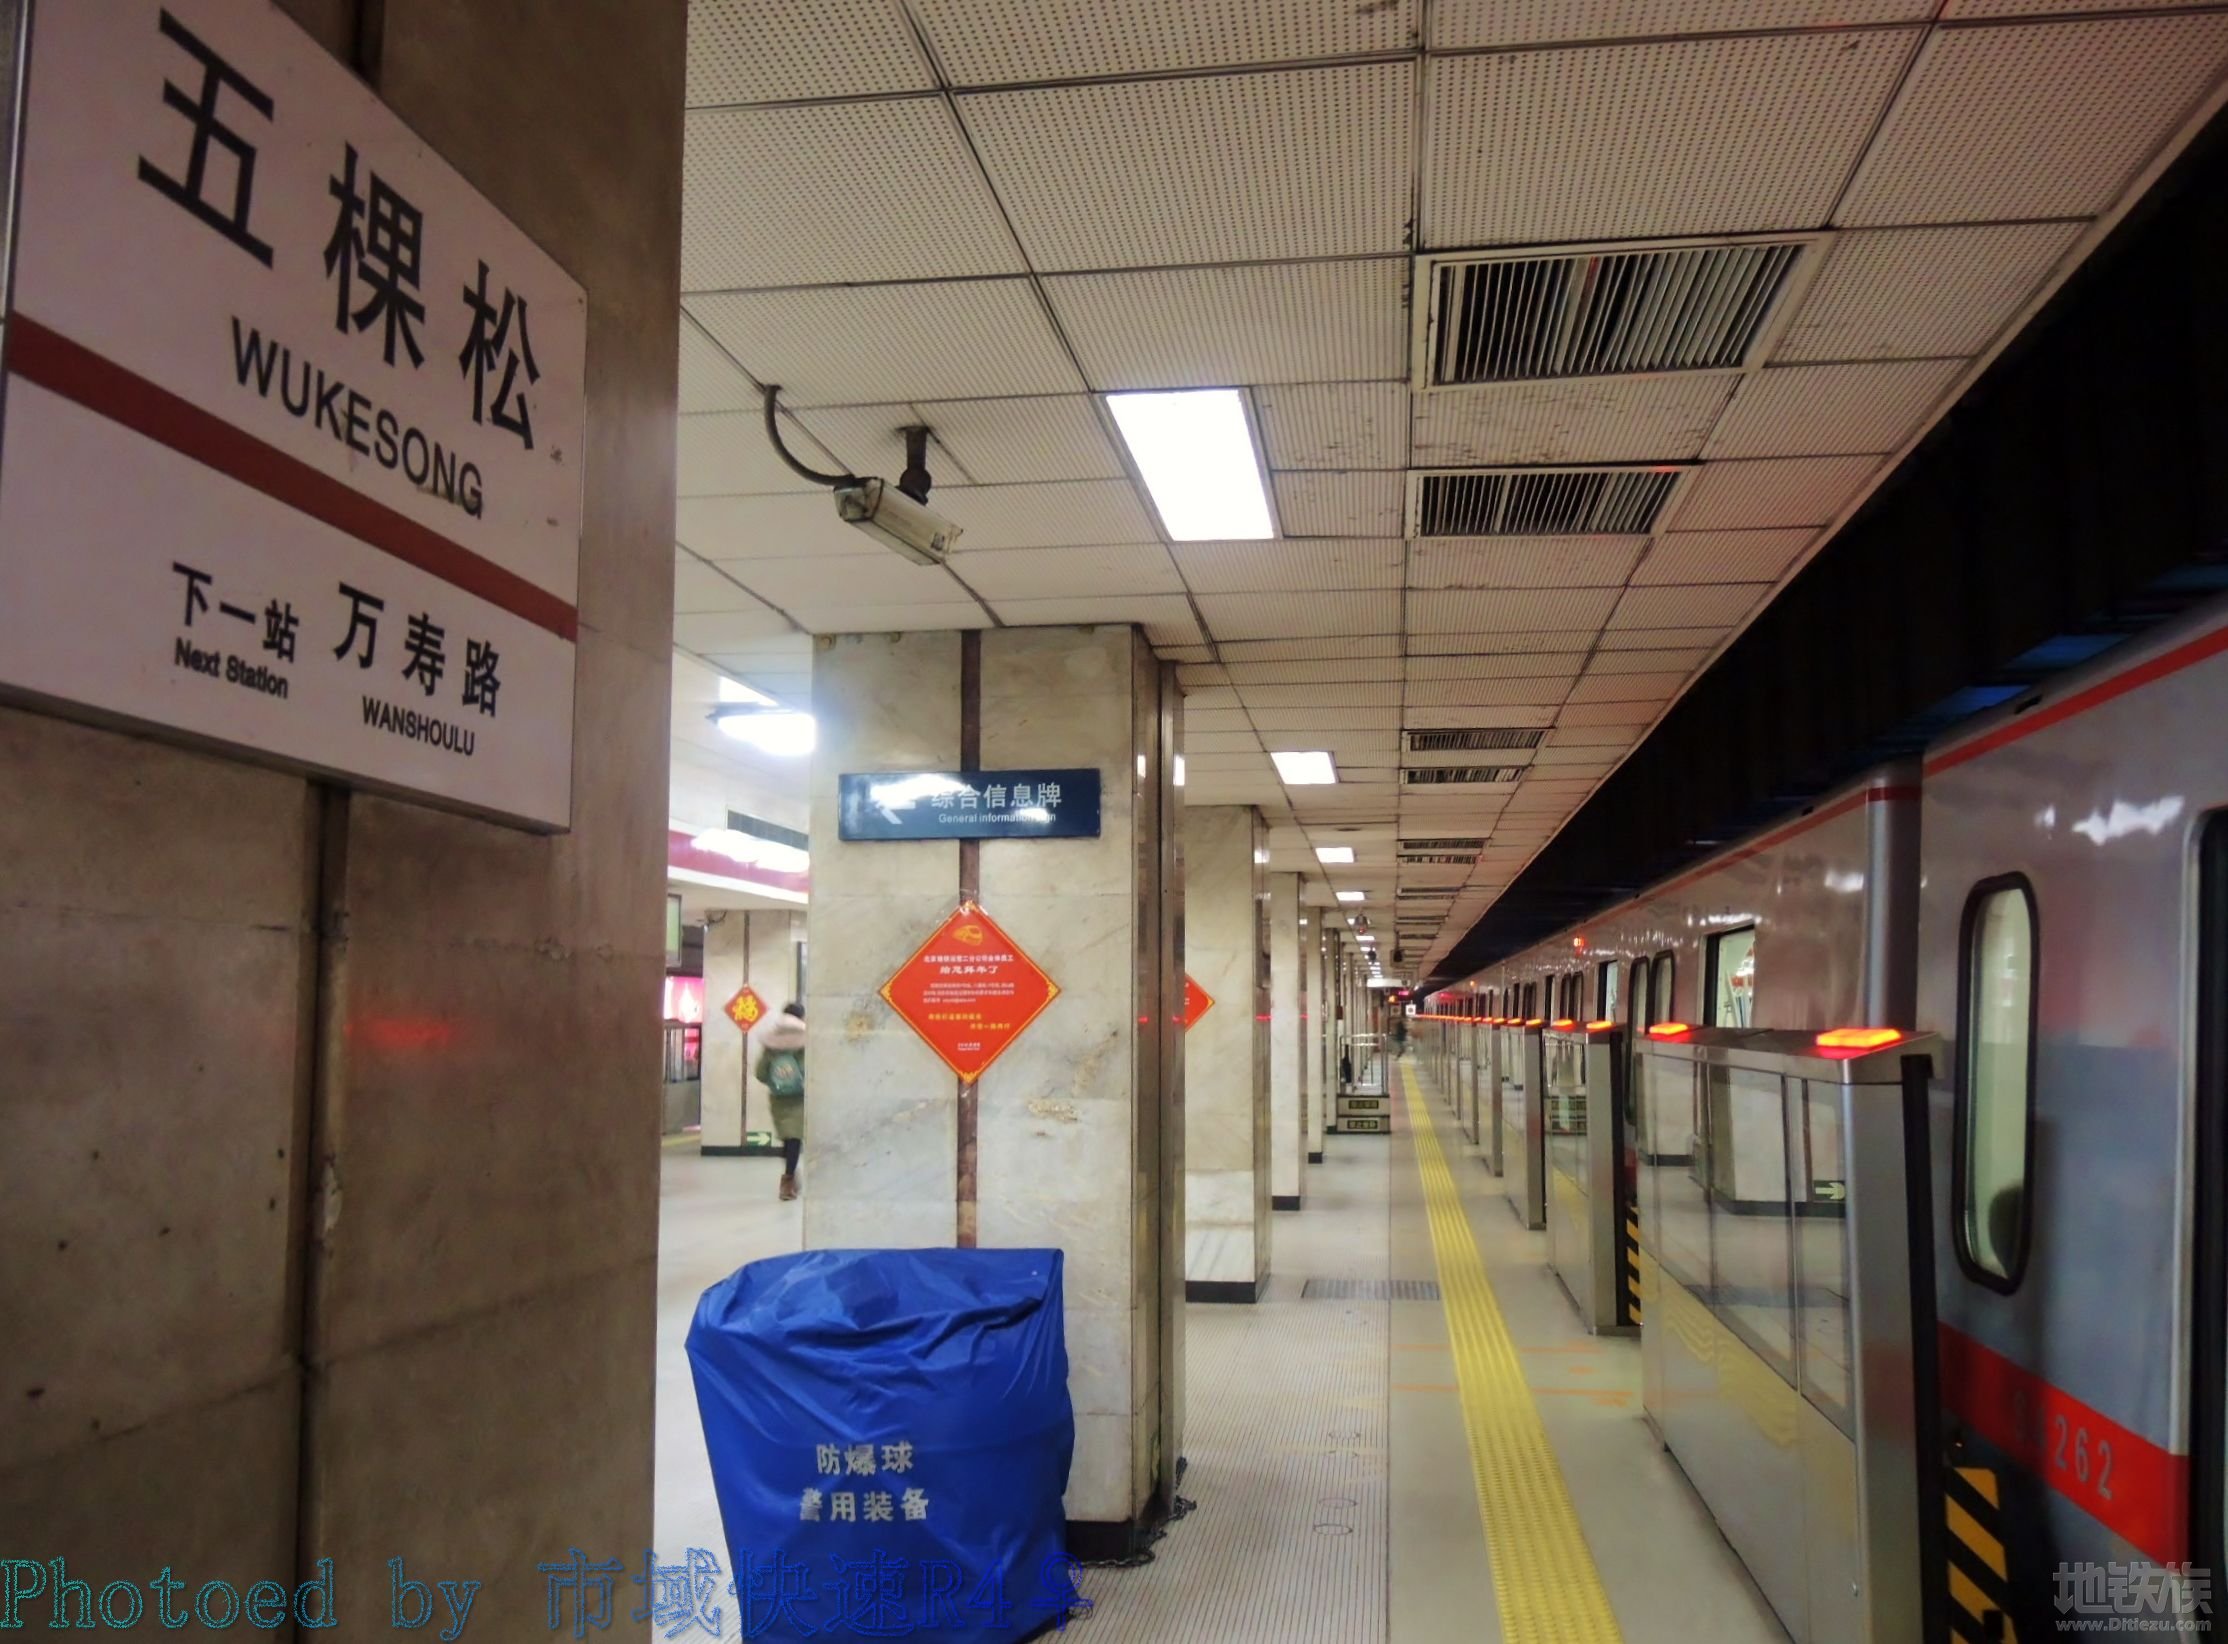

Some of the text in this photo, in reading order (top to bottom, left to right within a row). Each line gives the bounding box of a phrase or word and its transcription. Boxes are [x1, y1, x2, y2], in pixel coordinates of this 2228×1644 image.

[138, 7, 540, 450] 五棵松
[230, 315, 483, 519] WUKESONG
[173, 562, 500, 717] 下一站 万寿路
[174, 636, 288, 699] Next Station
[362, 695, 475, 756] WANSHOULU
[931, 782, 1061, 808] 综合信息牌
[938, 813, 977, 824] General
[815, 1441, 914, 1476] 防爆球
[799, 1487, 930, 1522] 警用装备
